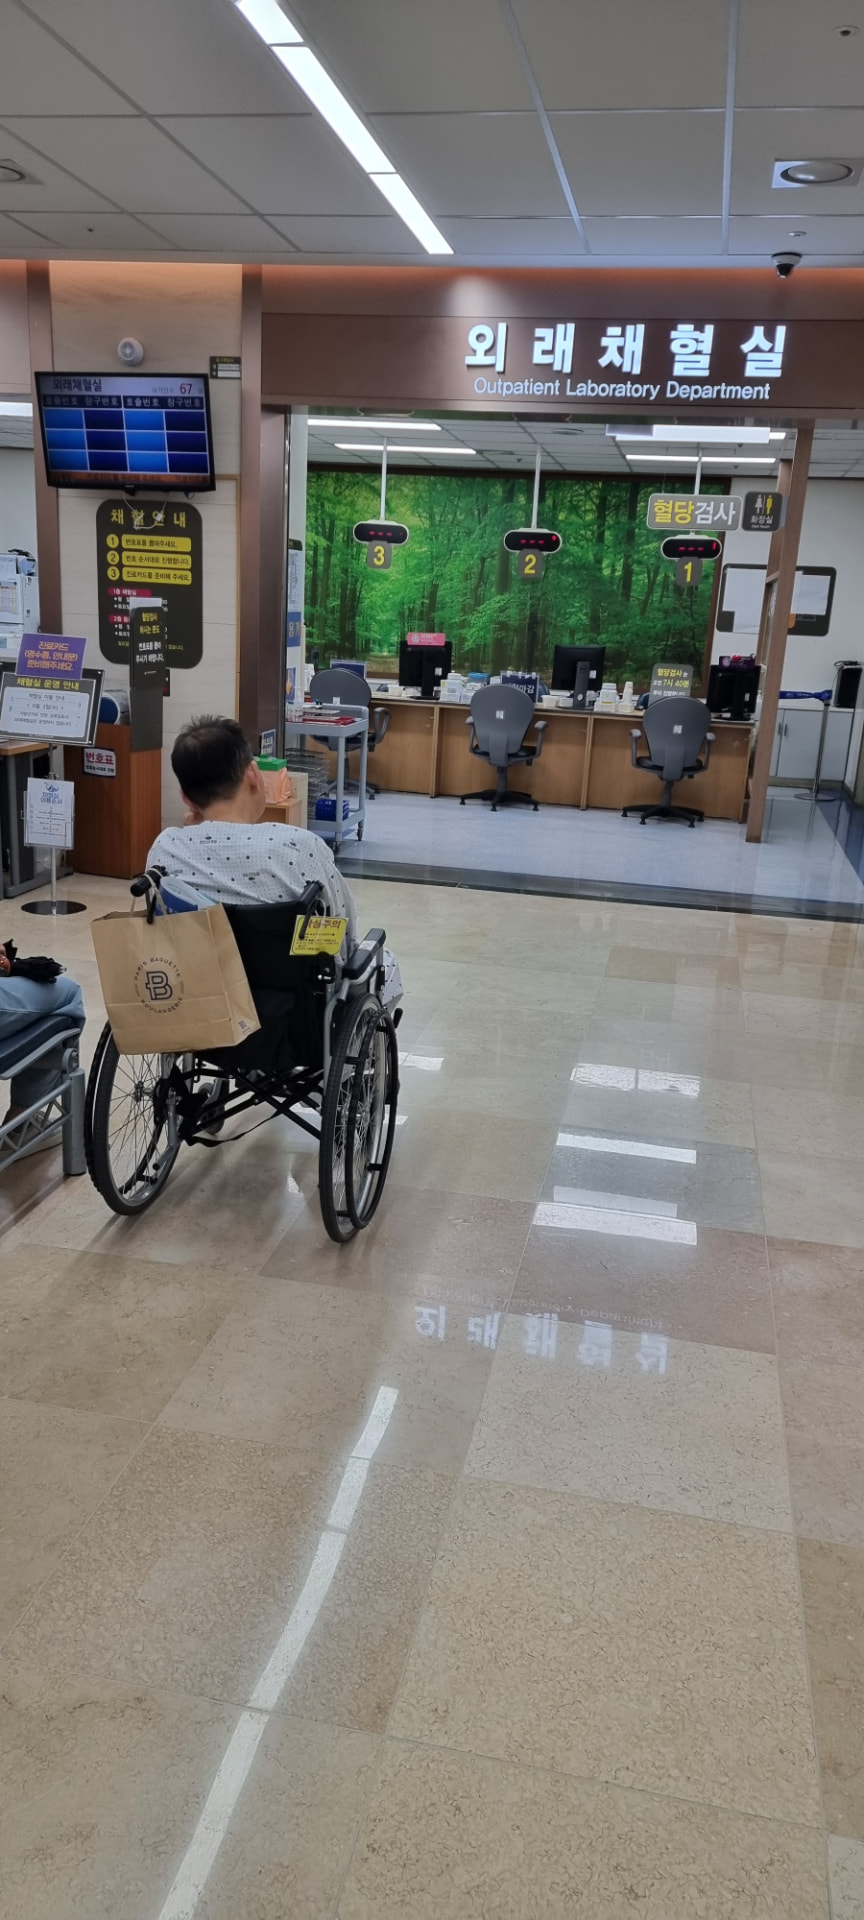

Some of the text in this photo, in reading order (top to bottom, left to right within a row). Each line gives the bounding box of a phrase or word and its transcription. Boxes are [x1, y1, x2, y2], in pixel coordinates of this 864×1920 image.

[53, 378, 102, 392] 외래채혈실
[179, 383, 193, 395] 67
[473, 377, 771, 401] Outpatient Laboratory Department
[654, 499, 736, 525] 혈당검사
[751, 515, 774, 524] 화장실
[110, 553, 116, 562] 2
[374, 546, 385, 566] 3
[524, 554, 536, 574] 2
[110, 569, 116, 578] 3
[684, 561, 693, 583] 1
[63, 681, 79, 691] 안내
[134, 957, 181, 981] PARIS BAGUETTE
